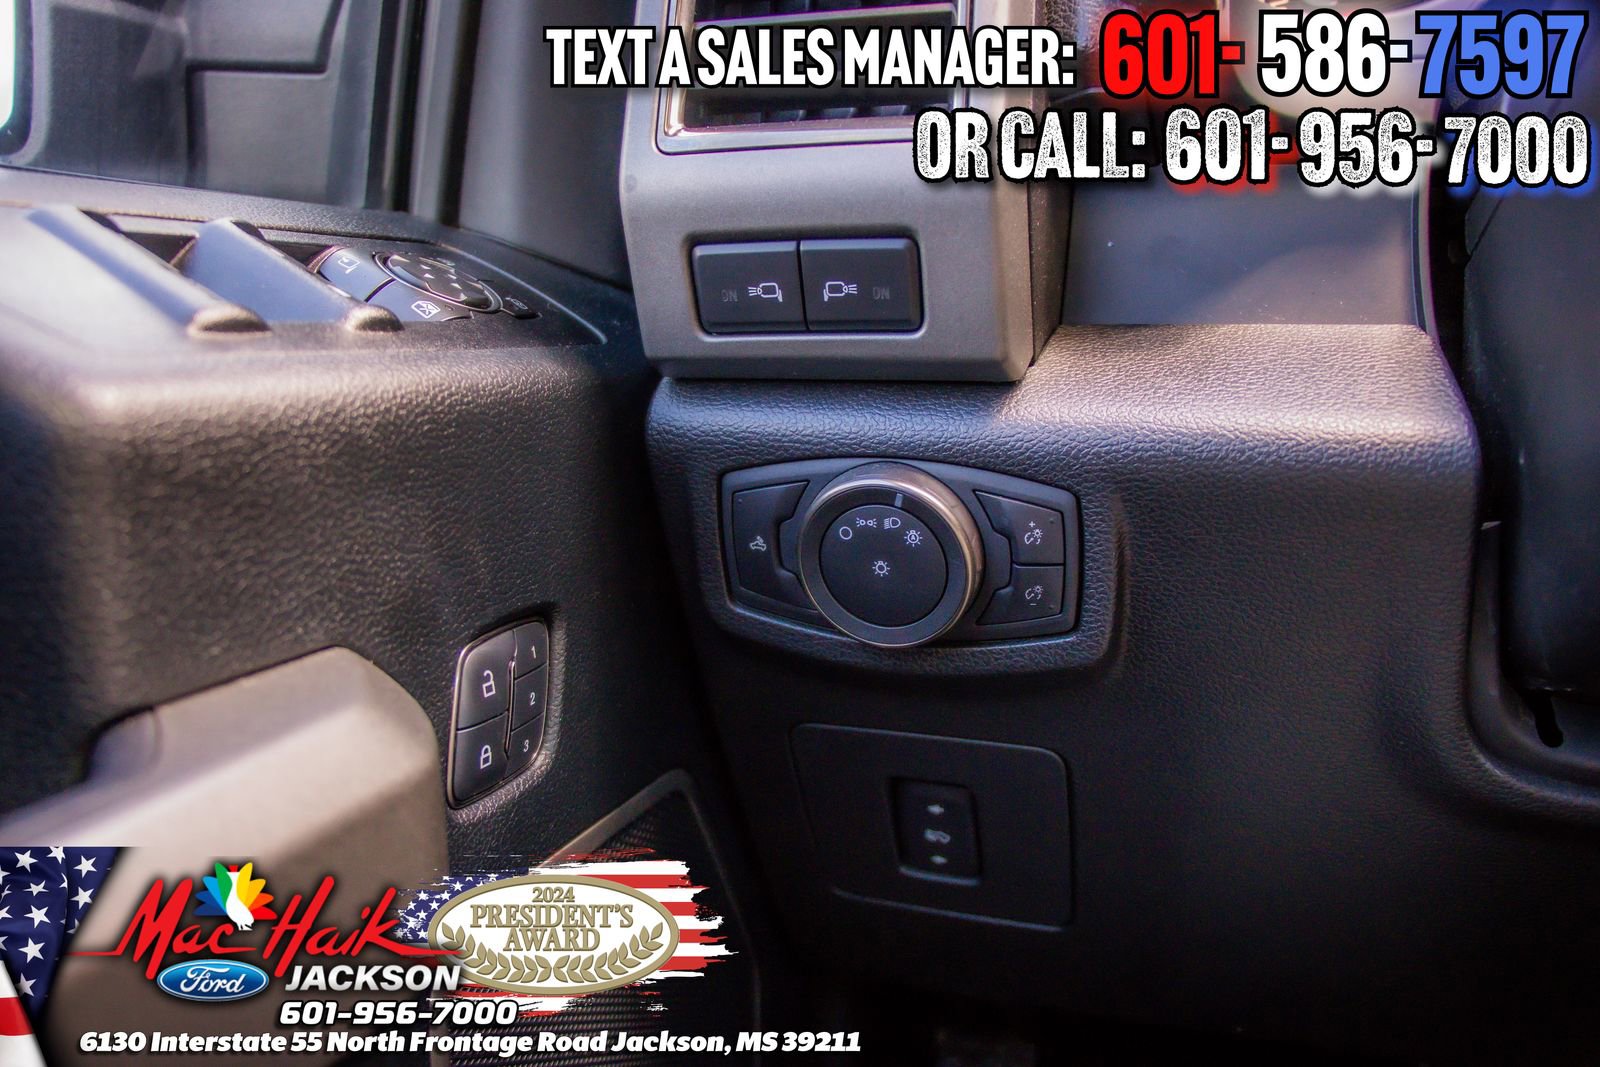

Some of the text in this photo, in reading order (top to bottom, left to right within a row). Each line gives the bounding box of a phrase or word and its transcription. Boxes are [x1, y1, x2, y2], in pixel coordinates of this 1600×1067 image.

[531, 645, 536, 659] 1
[529, 692, 536, 706] 2
[523, 739, 530, 753] 3
